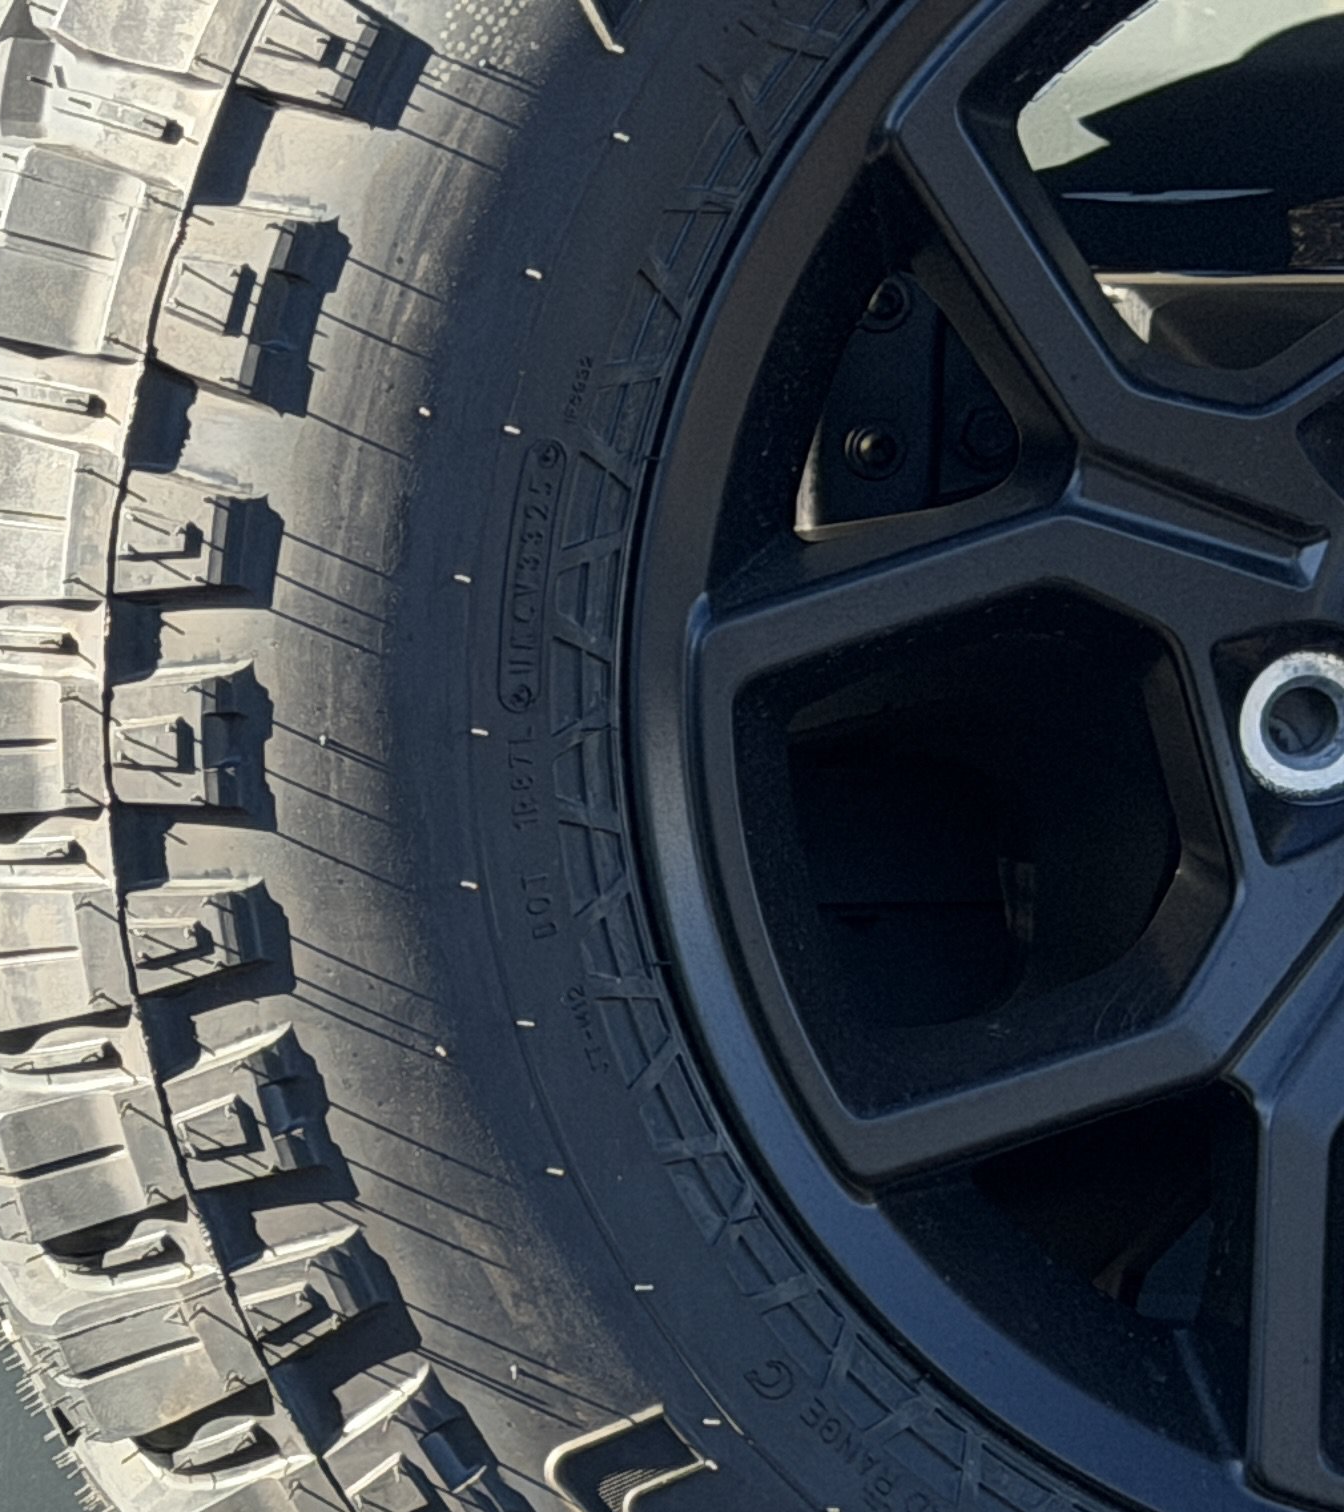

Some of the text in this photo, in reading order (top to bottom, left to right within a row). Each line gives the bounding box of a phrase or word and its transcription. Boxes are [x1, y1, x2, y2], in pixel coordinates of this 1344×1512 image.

[520, 873, 558, 940] DOT
[743, 1359, 794, 1400] C
[799, 1396, 899, 1497] RANGE
